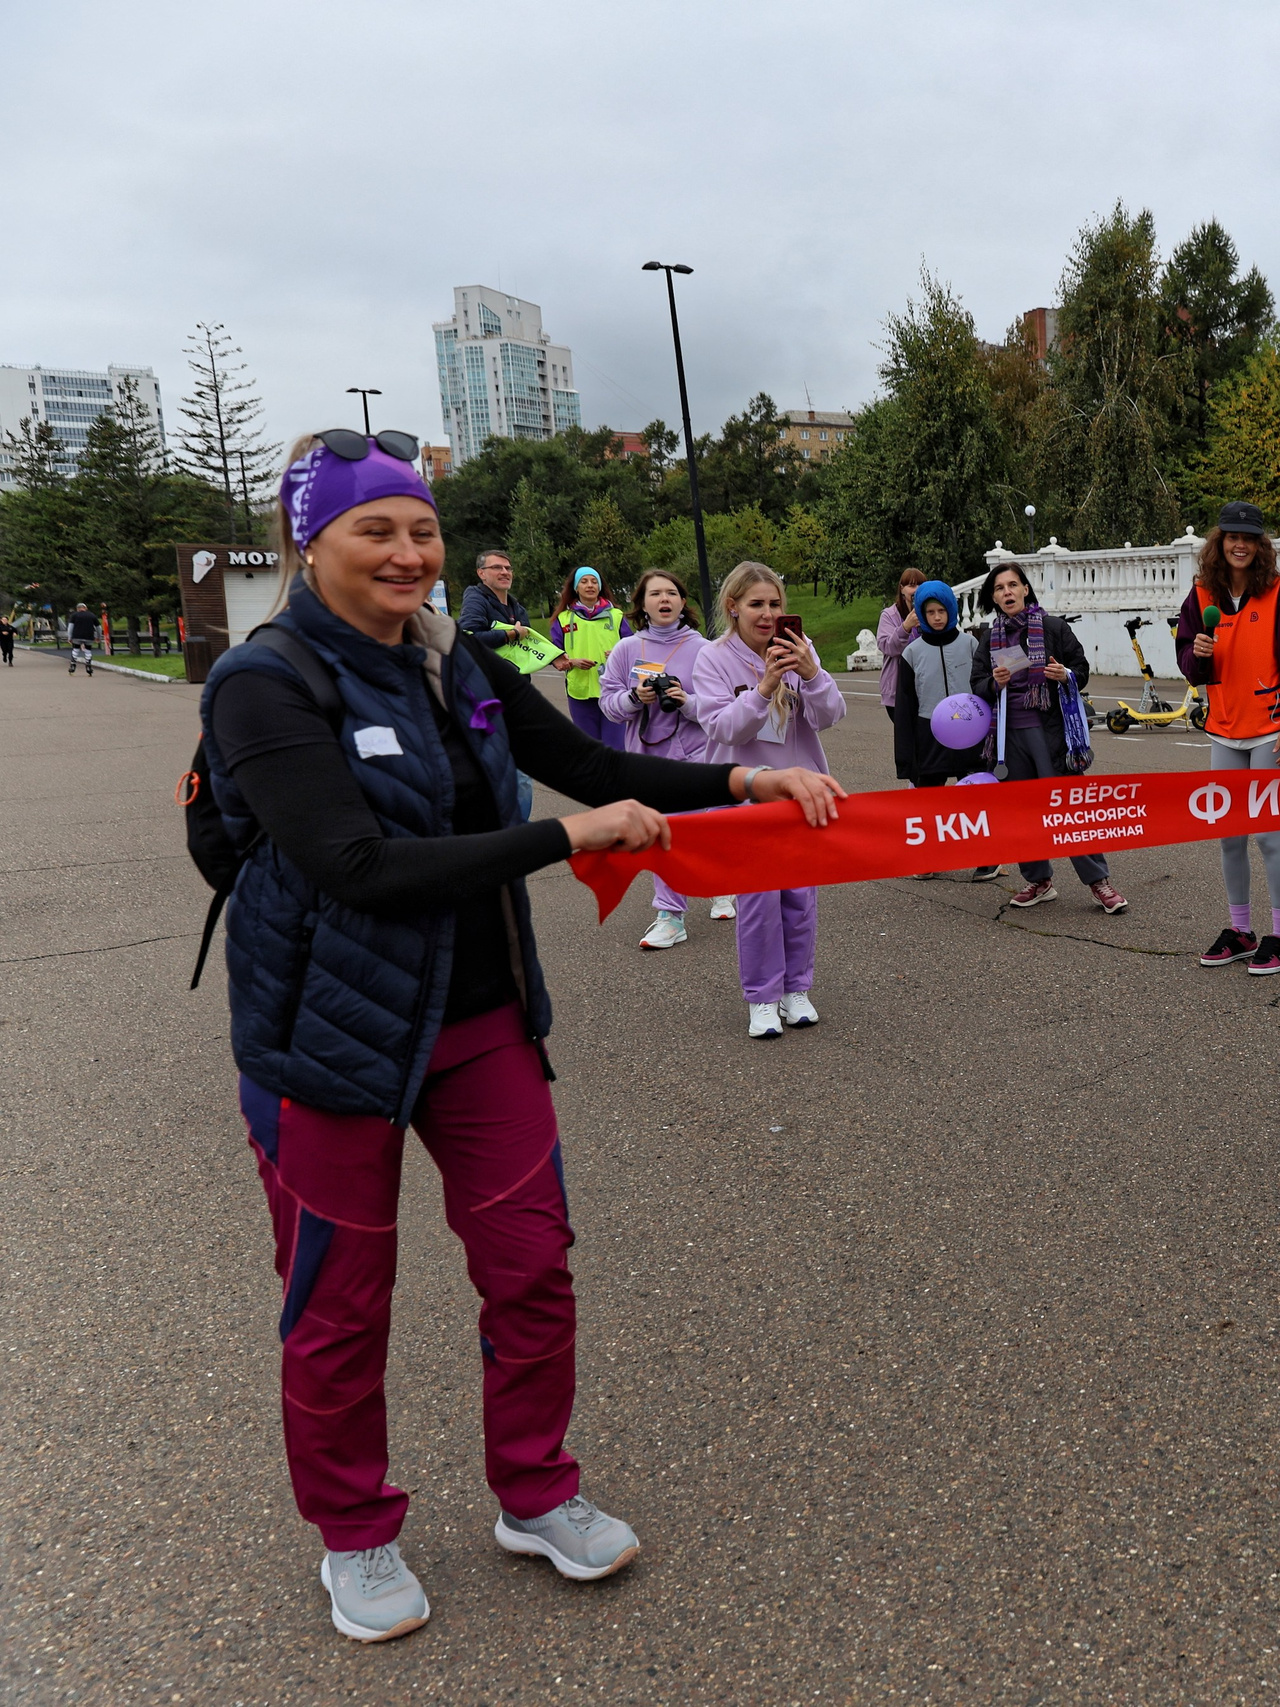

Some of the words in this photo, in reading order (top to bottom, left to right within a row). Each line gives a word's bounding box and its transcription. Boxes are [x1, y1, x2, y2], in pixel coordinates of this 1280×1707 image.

[228, 551, 279, 565] МОР
[1049, 789, 1063, 807] 5
[1069, 782, 1142, 805] ВЁРСТ
[905, 817, 926, 845] 5
[935, 810, 991, 842] КМ
[1042, 805, 1147, 828] КРАСНОЯРСК
[1052, 824, 1144, 845] НАБЕРЕЖНАЯ
